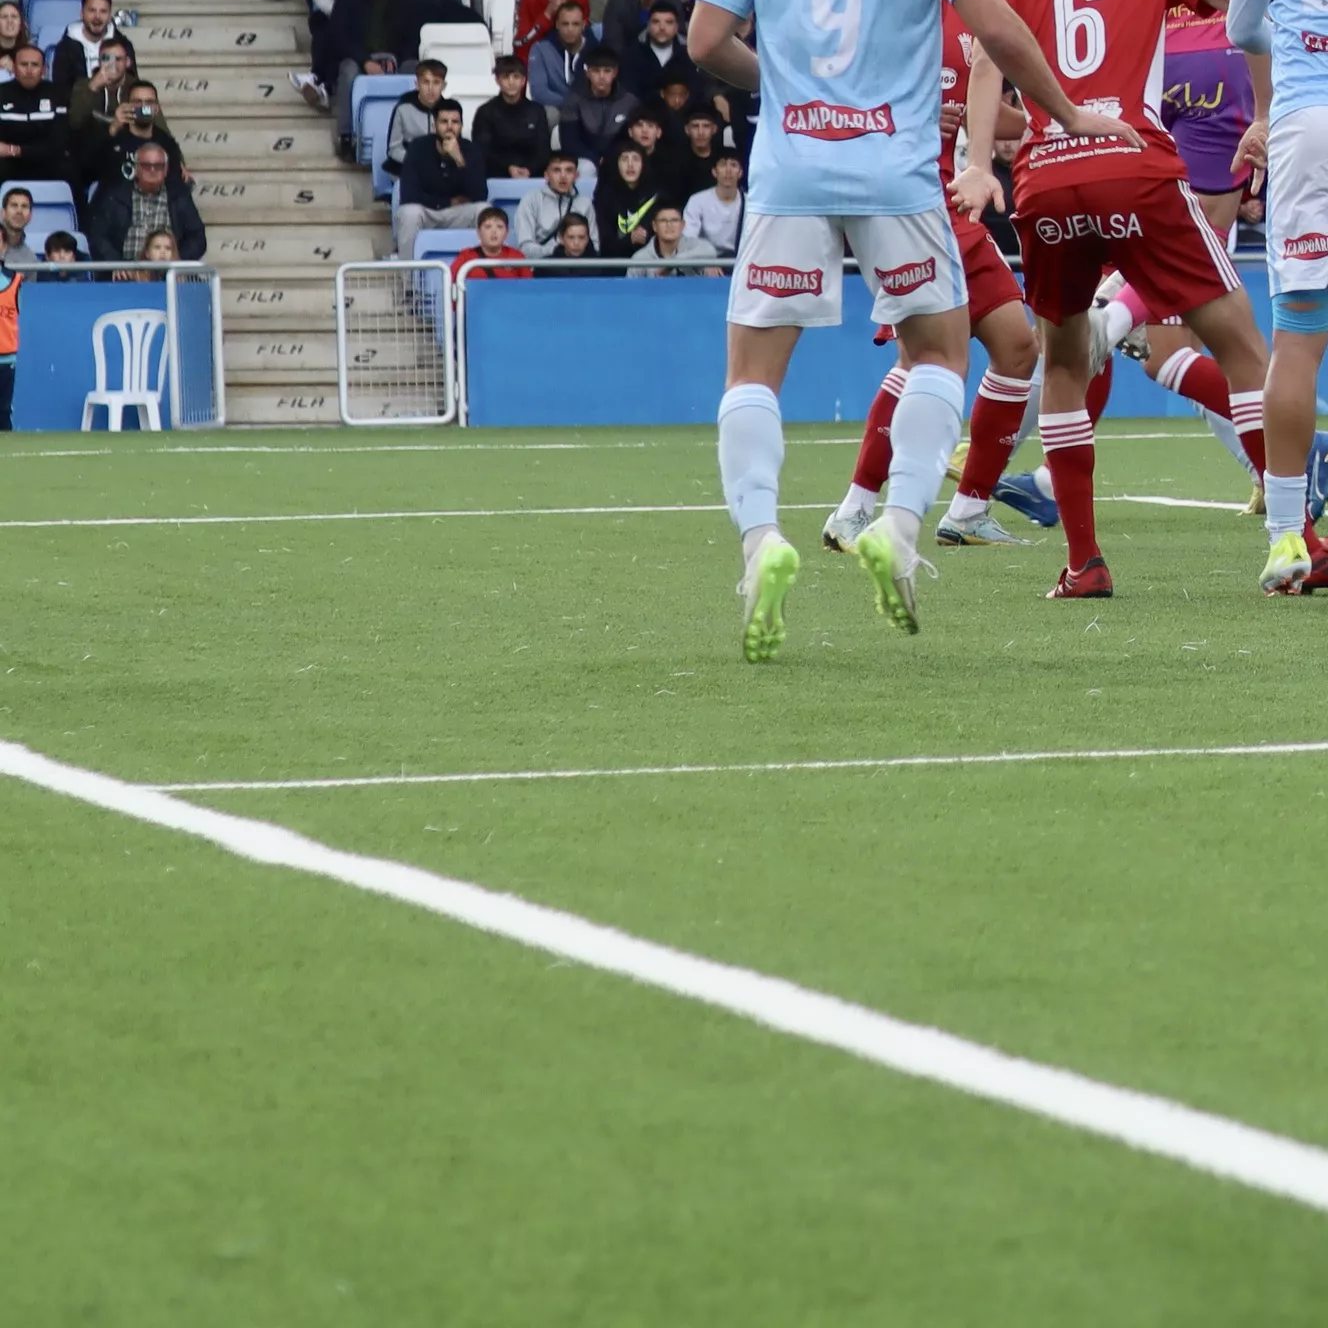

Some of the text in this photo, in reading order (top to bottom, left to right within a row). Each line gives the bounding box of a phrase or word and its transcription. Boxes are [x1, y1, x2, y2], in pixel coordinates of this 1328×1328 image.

[149, 28, 193, 40] FILA
[164, 79, 274, 98] FILA 7
[183, 131, 229, 143] FILA
[199, 185, 246, 197] FILA
[1063, 212, 1144, 240] JEALSA
[219, 240, 265, 252] FILA
[749, 268, 818, 290] CAMPOARAS
[236, 292, 284, 304] FILA
[256, 344, 304, 355] FILA
[277, 397, 325, 409] FILA
